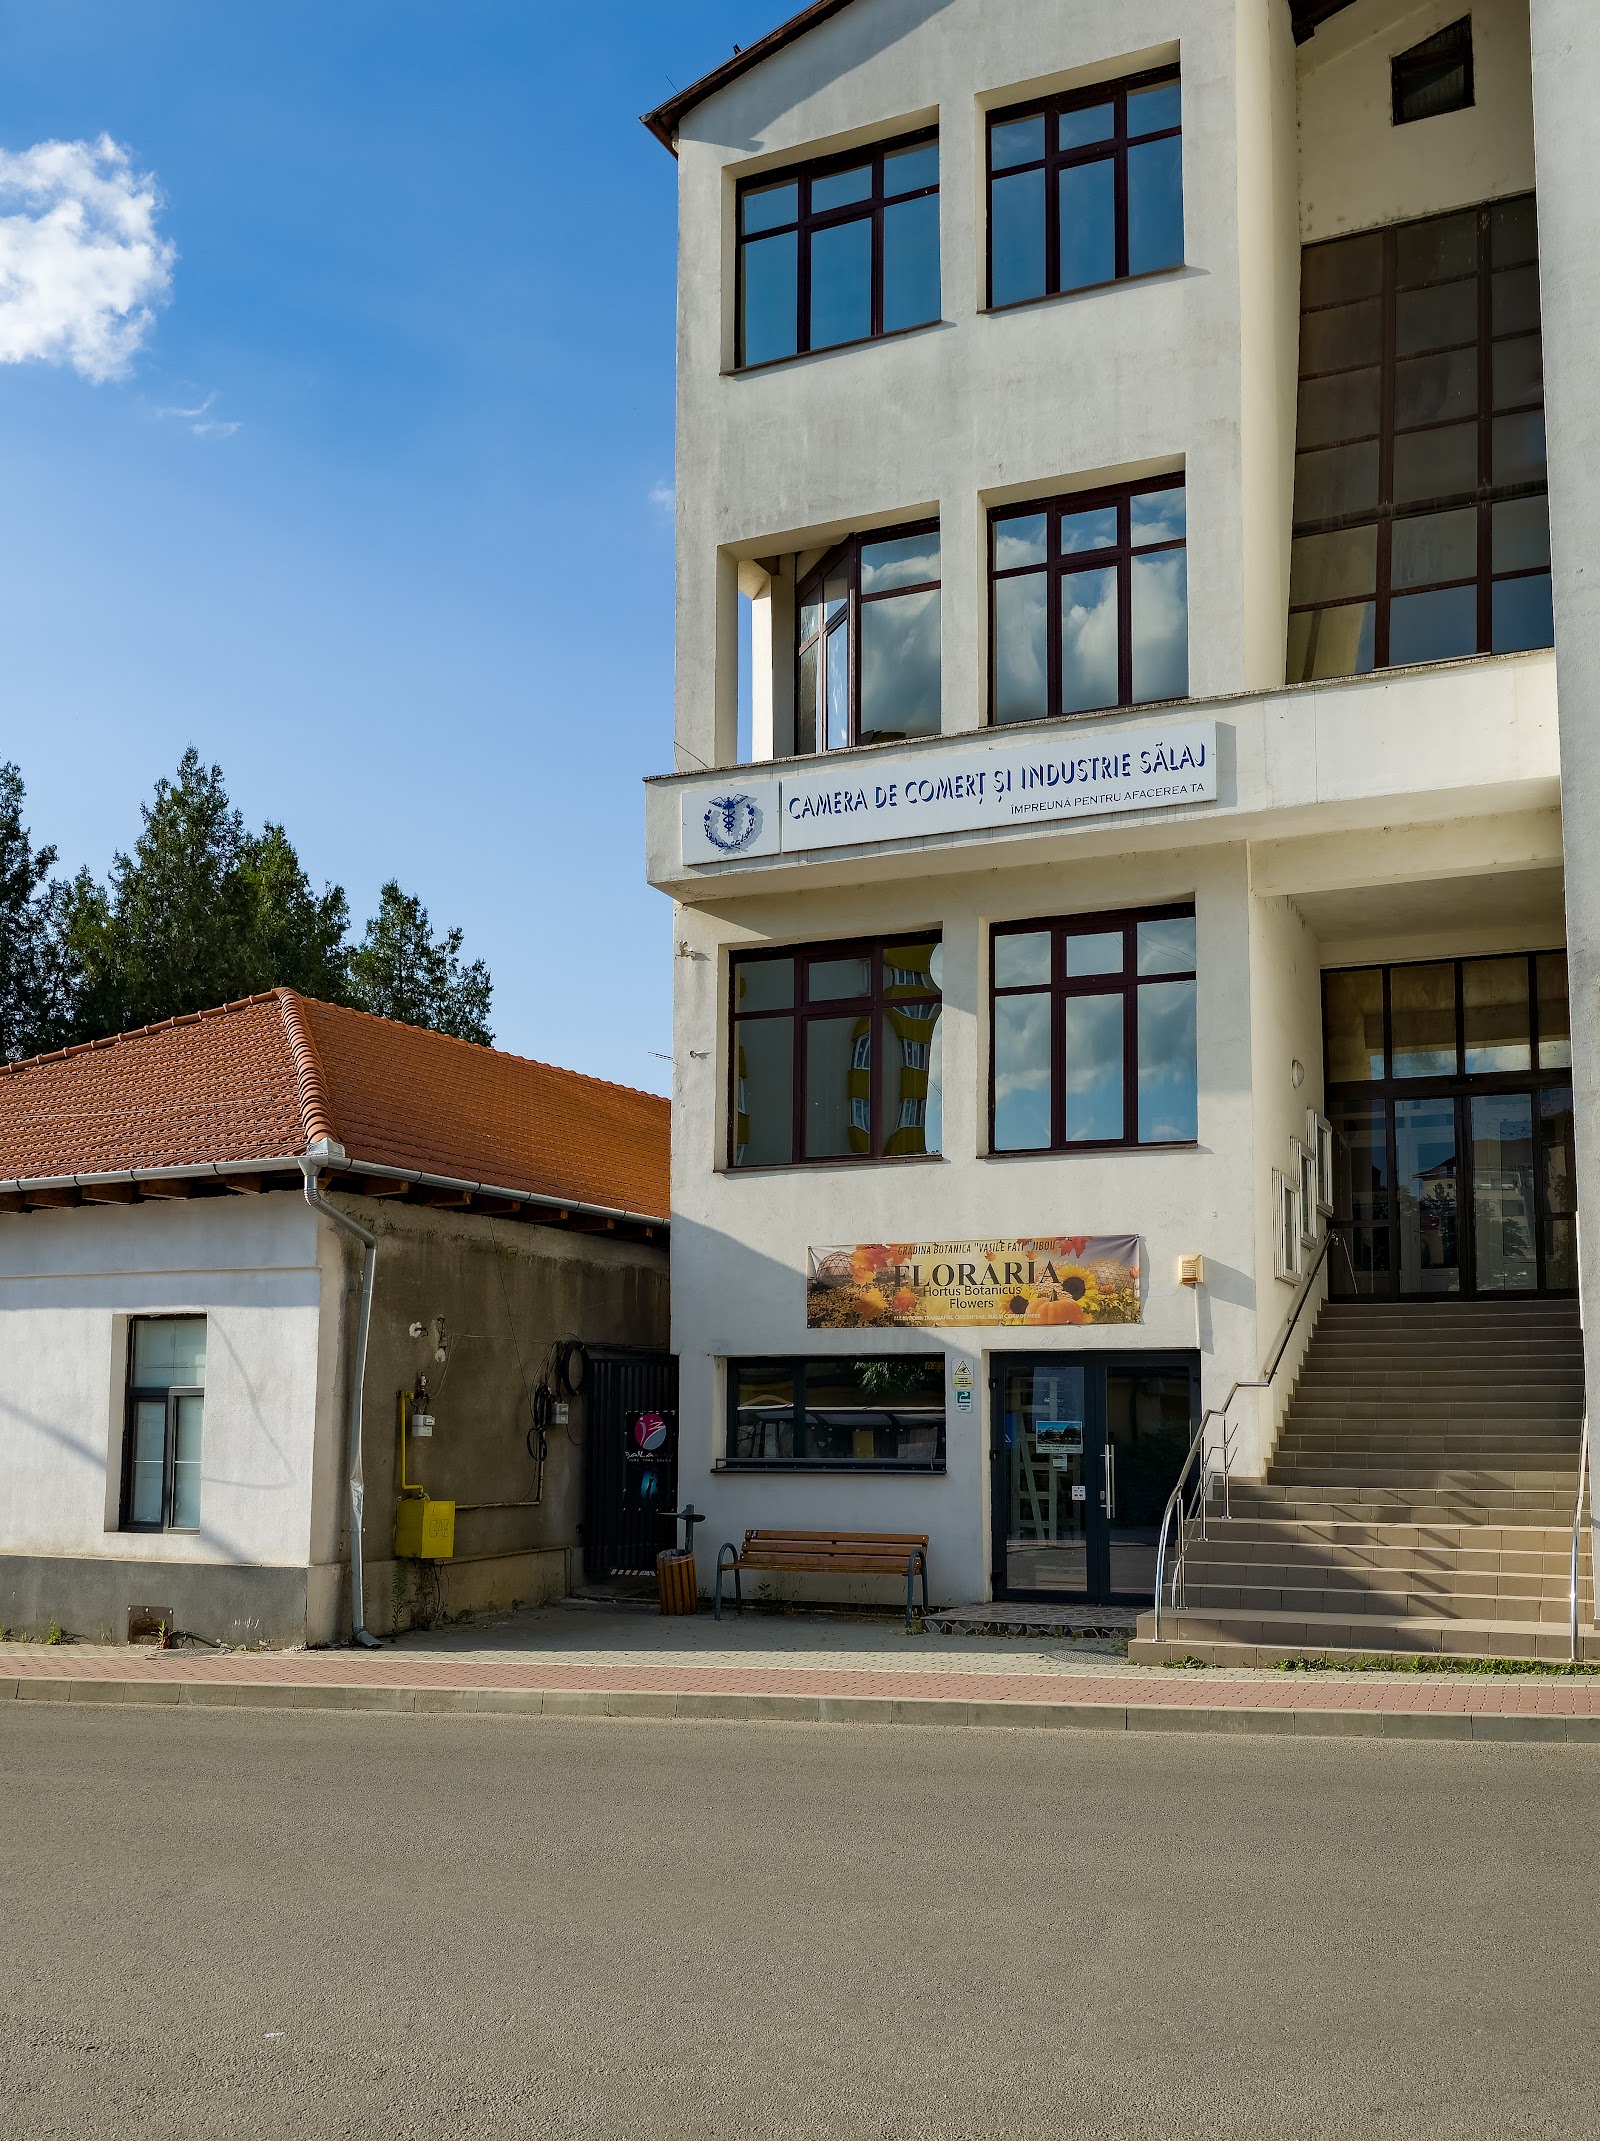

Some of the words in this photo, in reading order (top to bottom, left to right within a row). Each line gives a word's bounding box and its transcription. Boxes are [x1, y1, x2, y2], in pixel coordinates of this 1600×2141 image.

[788, 788, 868, 819] CAMERA
[875, 784, 898, 809] DE
[1021, 753, 1131, 789] INDUSTRIE
[1074, 793, 1121, 807] PENTRU
[1123, 786, 1188, 801] AFACEREA
[1190, 783, 1205, 793] TA
[898, 1245, 931, 1255] GRADINA
[933, 1244, 971, 1254] BOTANICA
[894, 1260, 1061, 1287] FLORARIA
[923, 1285, 961, 1297] Hortus
[964, 1285, 1022, 1296] Botanicus
[950, 1298, 994, 1309] Flowers
